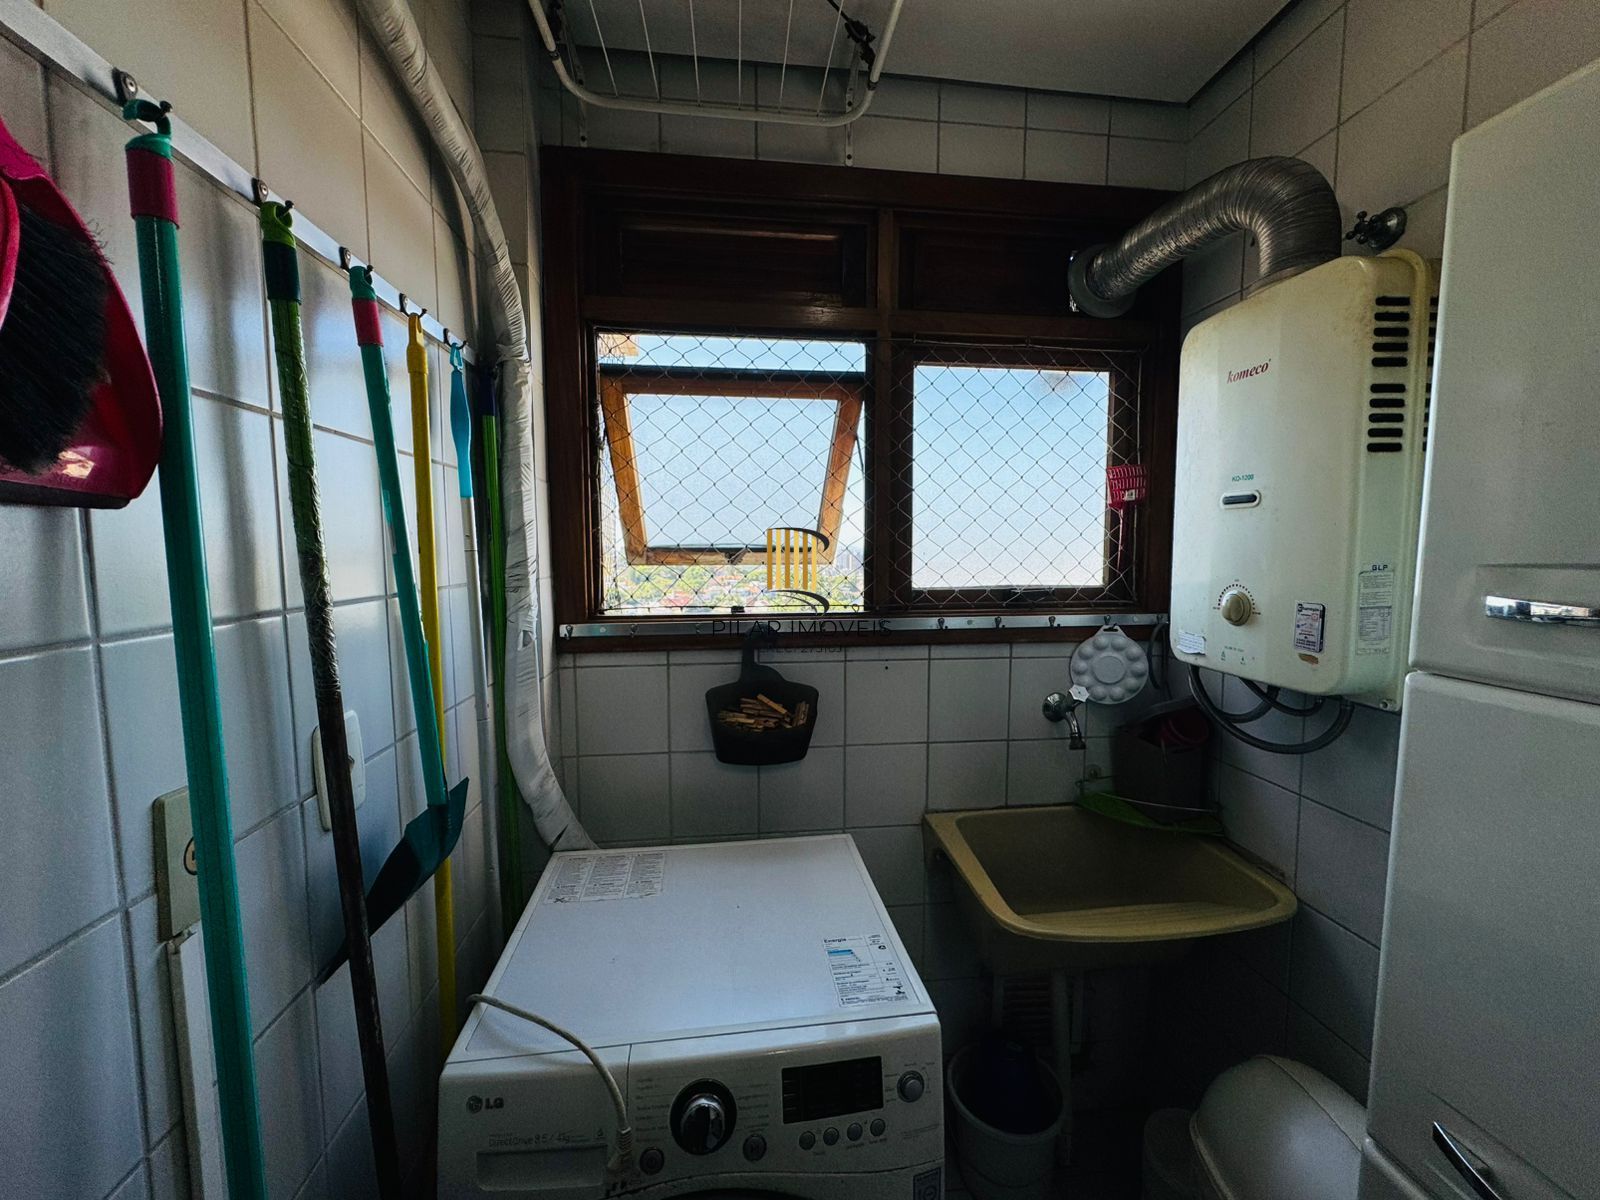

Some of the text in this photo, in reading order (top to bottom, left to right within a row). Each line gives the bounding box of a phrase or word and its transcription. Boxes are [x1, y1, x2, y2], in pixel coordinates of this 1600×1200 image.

[1227, 360, 1270, 384] komeco
[1371, 563, 1389, 571] GLP
[484, 1097, 505, 1109] LG
